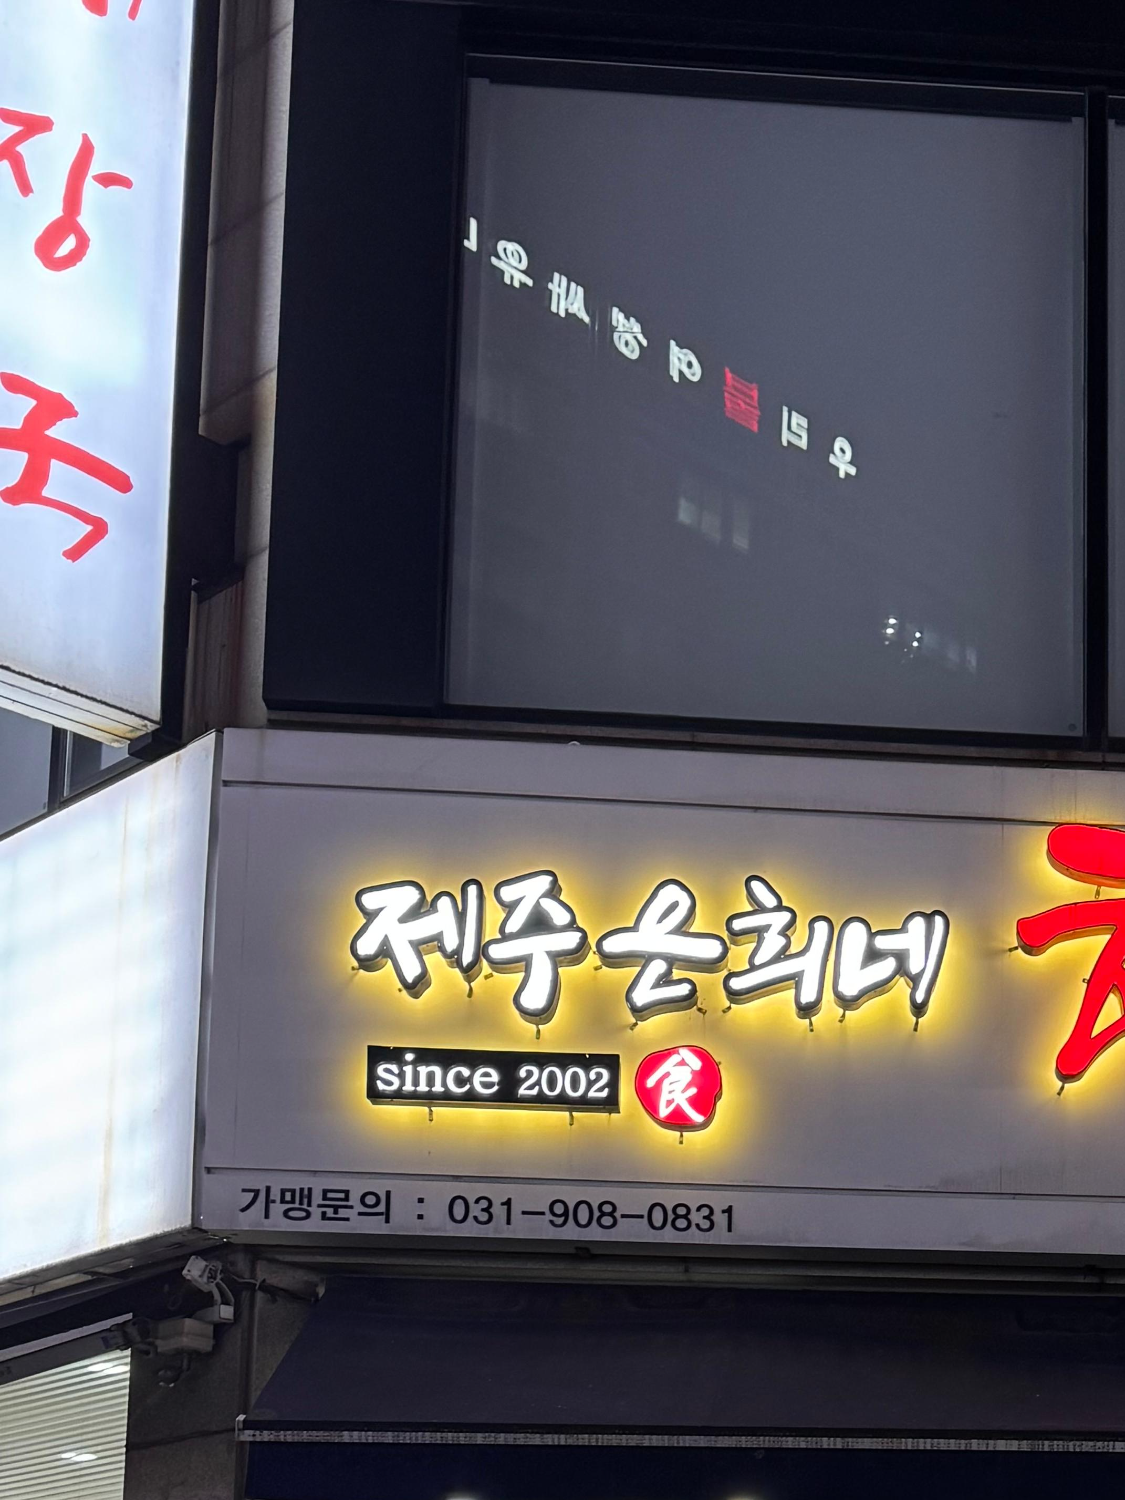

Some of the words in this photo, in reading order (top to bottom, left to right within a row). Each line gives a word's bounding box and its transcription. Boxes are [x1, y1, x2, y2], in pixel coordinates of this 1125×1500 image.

[0, 0, 134, 563] 장국
[375, 1052, 500, 1095] since
[517, 1064, 611, 1099] 2002
[646, 1048, 704, 1124] 食
[239, 1185, 392, 1225] 가맹문의
[448, 1194, 736, 1233] 031-908-0831
